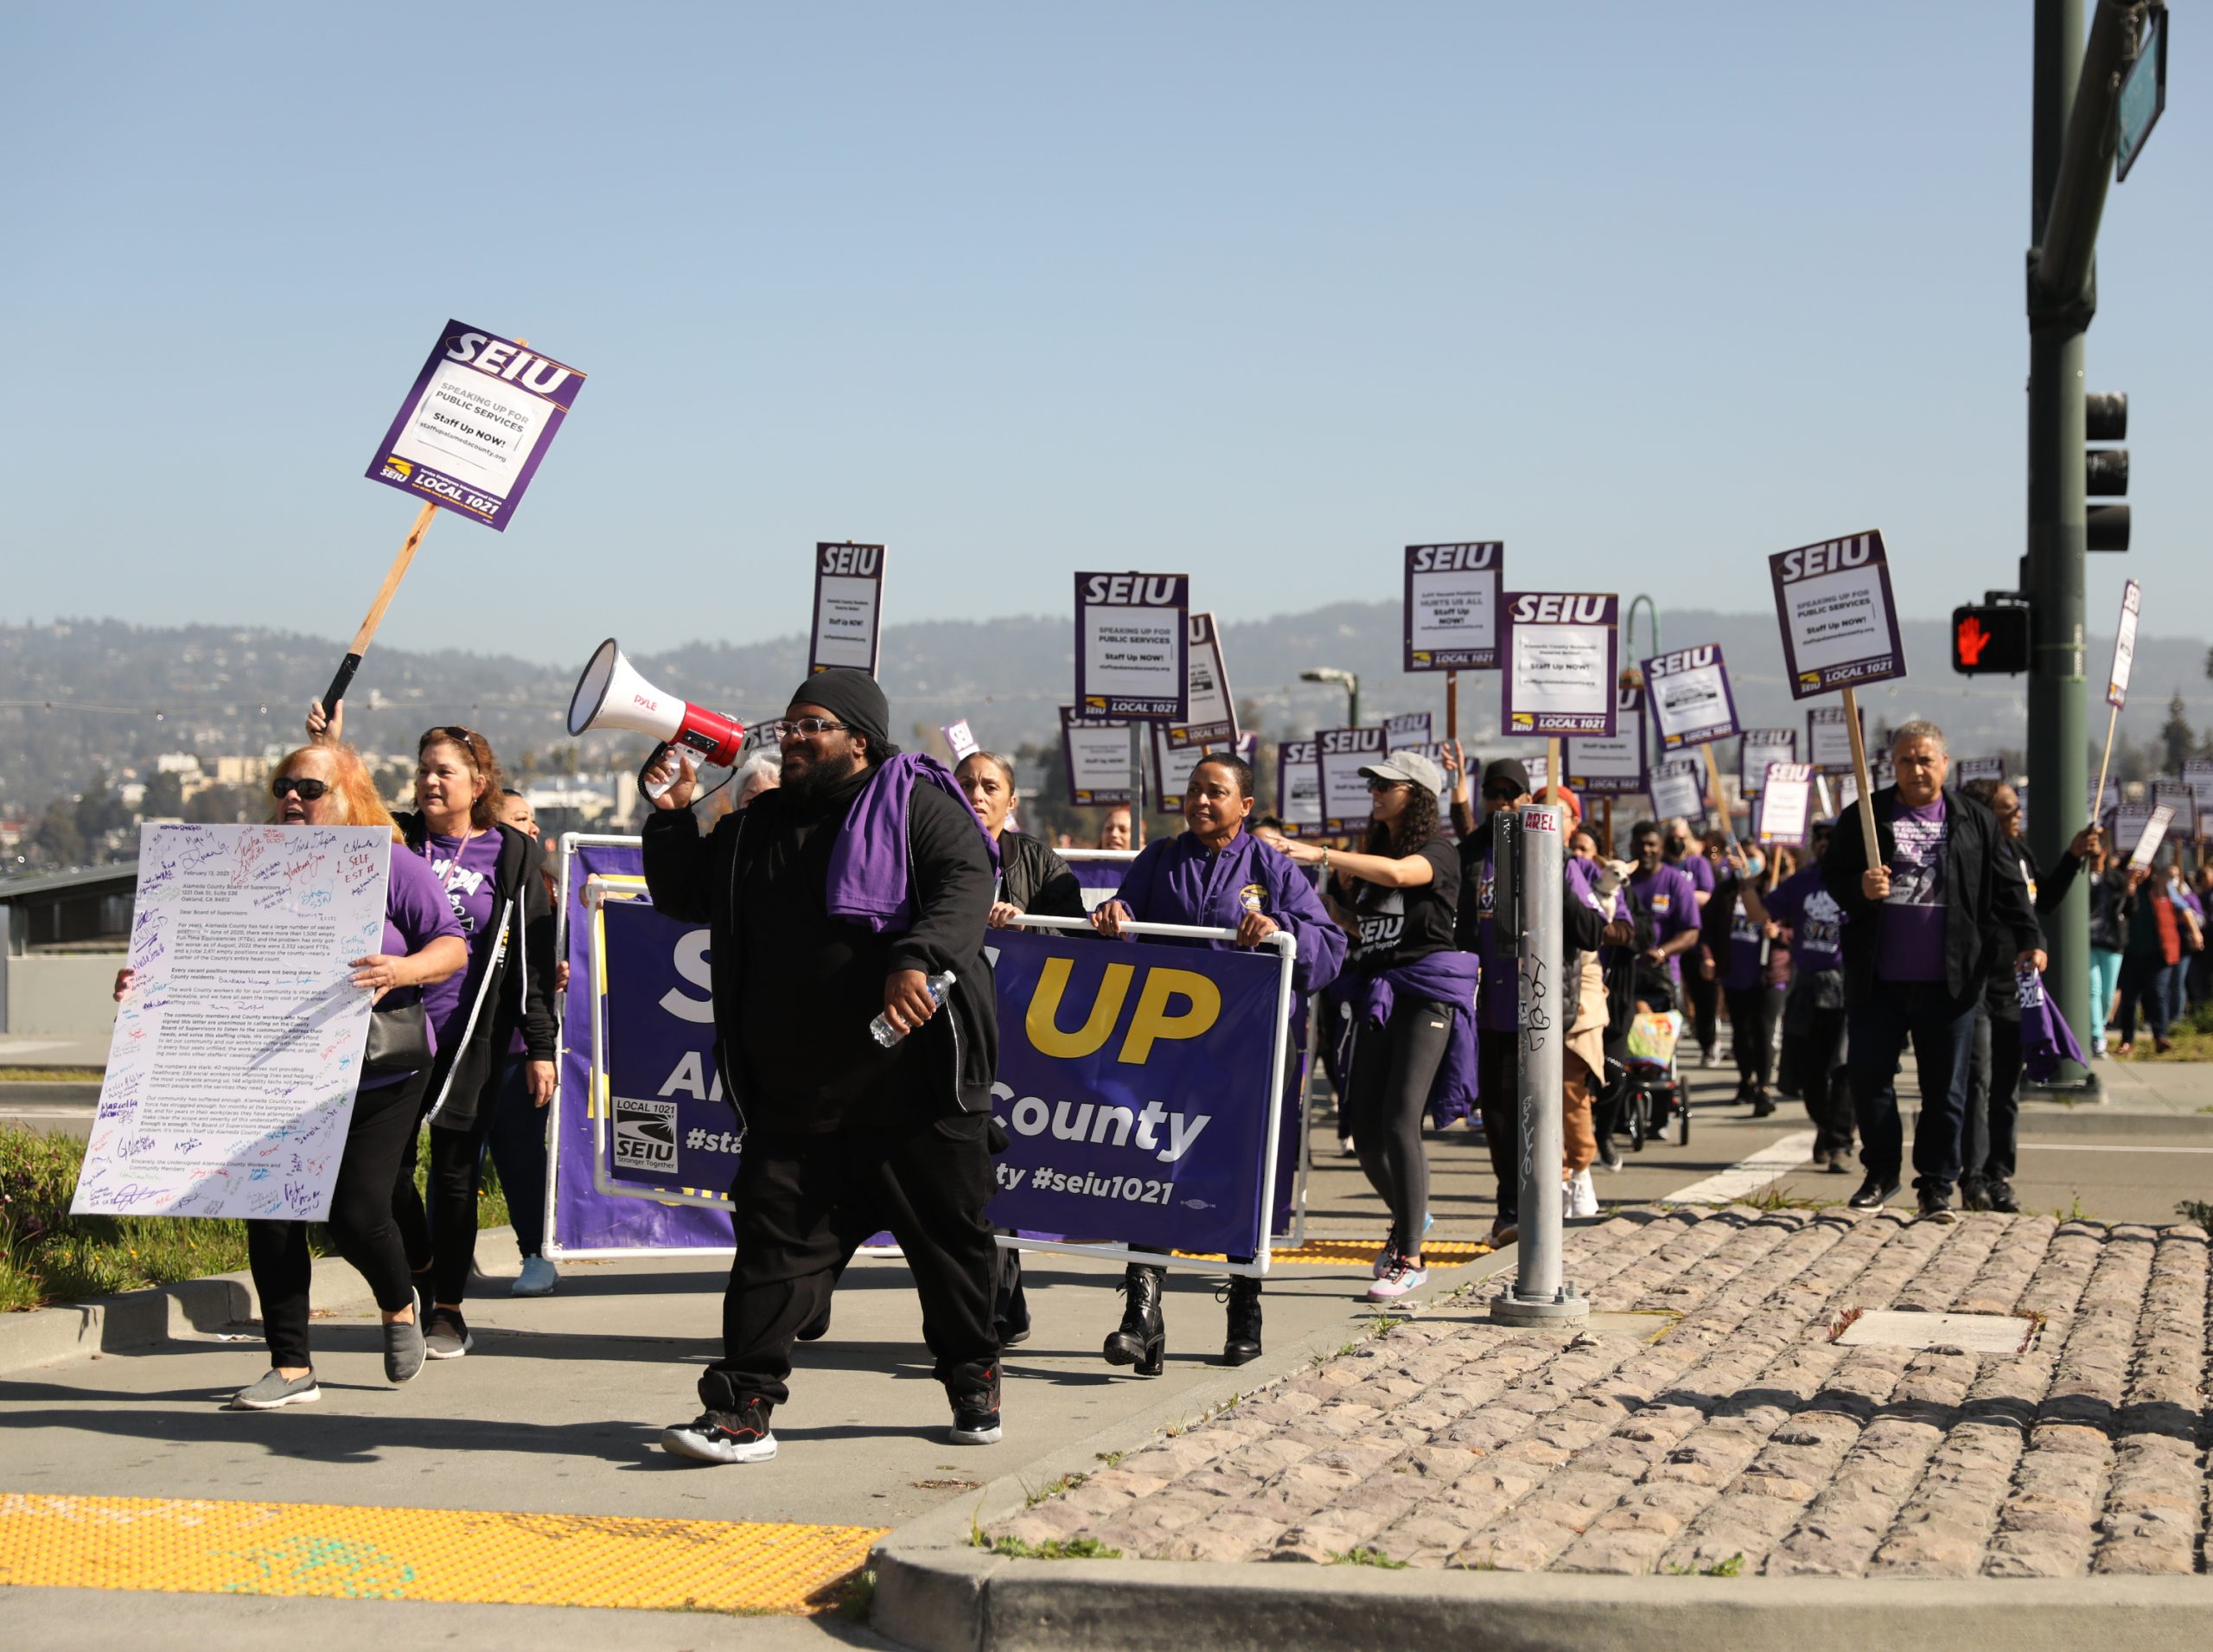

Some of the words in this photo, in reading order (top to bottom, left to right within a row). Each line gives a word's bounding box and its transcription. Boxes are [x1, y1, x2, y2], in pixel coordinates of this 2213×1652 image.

[446, 333, 571, 394] SEIU
[436, 391, 473, 410] PUBLIC
[474, 407, 524, 432] SERVICES
[441, 382, 491, 406] SPEAKING
[493, 403, 507, 412] UP
[507, 410, 529, 424] FOR
[433, 412, 460, 427] Staff
[460, 423, 474, 434] Up
[475, 431, 506, 448] NOW!
[420, 422, 507, 462] staffupalamedacounty.org
[380, 469, 409, 482] SEIU
[414, 475, 462, 501] LOCAL
[465, 494, 499, 514] 1021
[822, 546, 878, 575] SEIU
[1413, 544, 1494, 572] SEIU
[1783, 533, 1870, 583] SEIU
[1086, 576, 1176, 604] SEIU
[1797, 595, 1837, 609] SPEAKING
[1839, 592, 1850, 601] UP
[1853, 590, 1869, 598] FOR
[1514, 595, 1607, 623] SEIU
[1798, 606, 1827, 618] PUBLIC
[1828, 598, 1871, 611] SERVICES
[1807, 624, 1827, 635] Staff
[1842, 616, 1866, 626] NOW!
[1435, 654, 1469, 664] LOCAL
[1650, 647, 1713, 678] SEIU
[1826, 667, 1863, 682] LOCAL
[1866, 660, 1892, 673] 1021
[1801, 682, 1821, 693] SEIU
[634, 694, 658, 711] PYLE
[1112, 703, 1149, 711] LOCAL
[1152, 703, 1177, 712] 1021
[1387, 715, 1427, 731] SEIU
[1539, 718, 1577, 728] LOCAL
[1580, 719, 1606, 729] 1021
[1323, 730, 1381, 753] SEIU
[1746, 730, 1792, 746] SEIU
[1285, 743, 1317, 763] SE
[1770, 763, 1811, 781] SEIU
[1525, 813, 1556, 831] AREL
[1359, 916, 1404, 944] SEIU
[1024, 956, 1221, 1065] UP
[617, 1100, 650, 1112] LOCAL
[654, 1105, 674, 1114] 1021
[990, 1081, 1212, 1163] County
[616, 1140, 673, 1160] SEIU
[618, 1156, 644, 1165] Stronger
[647, 1160, 674, 1169] Together
[1031, 1166, 1174, 1205] #seiu1021
